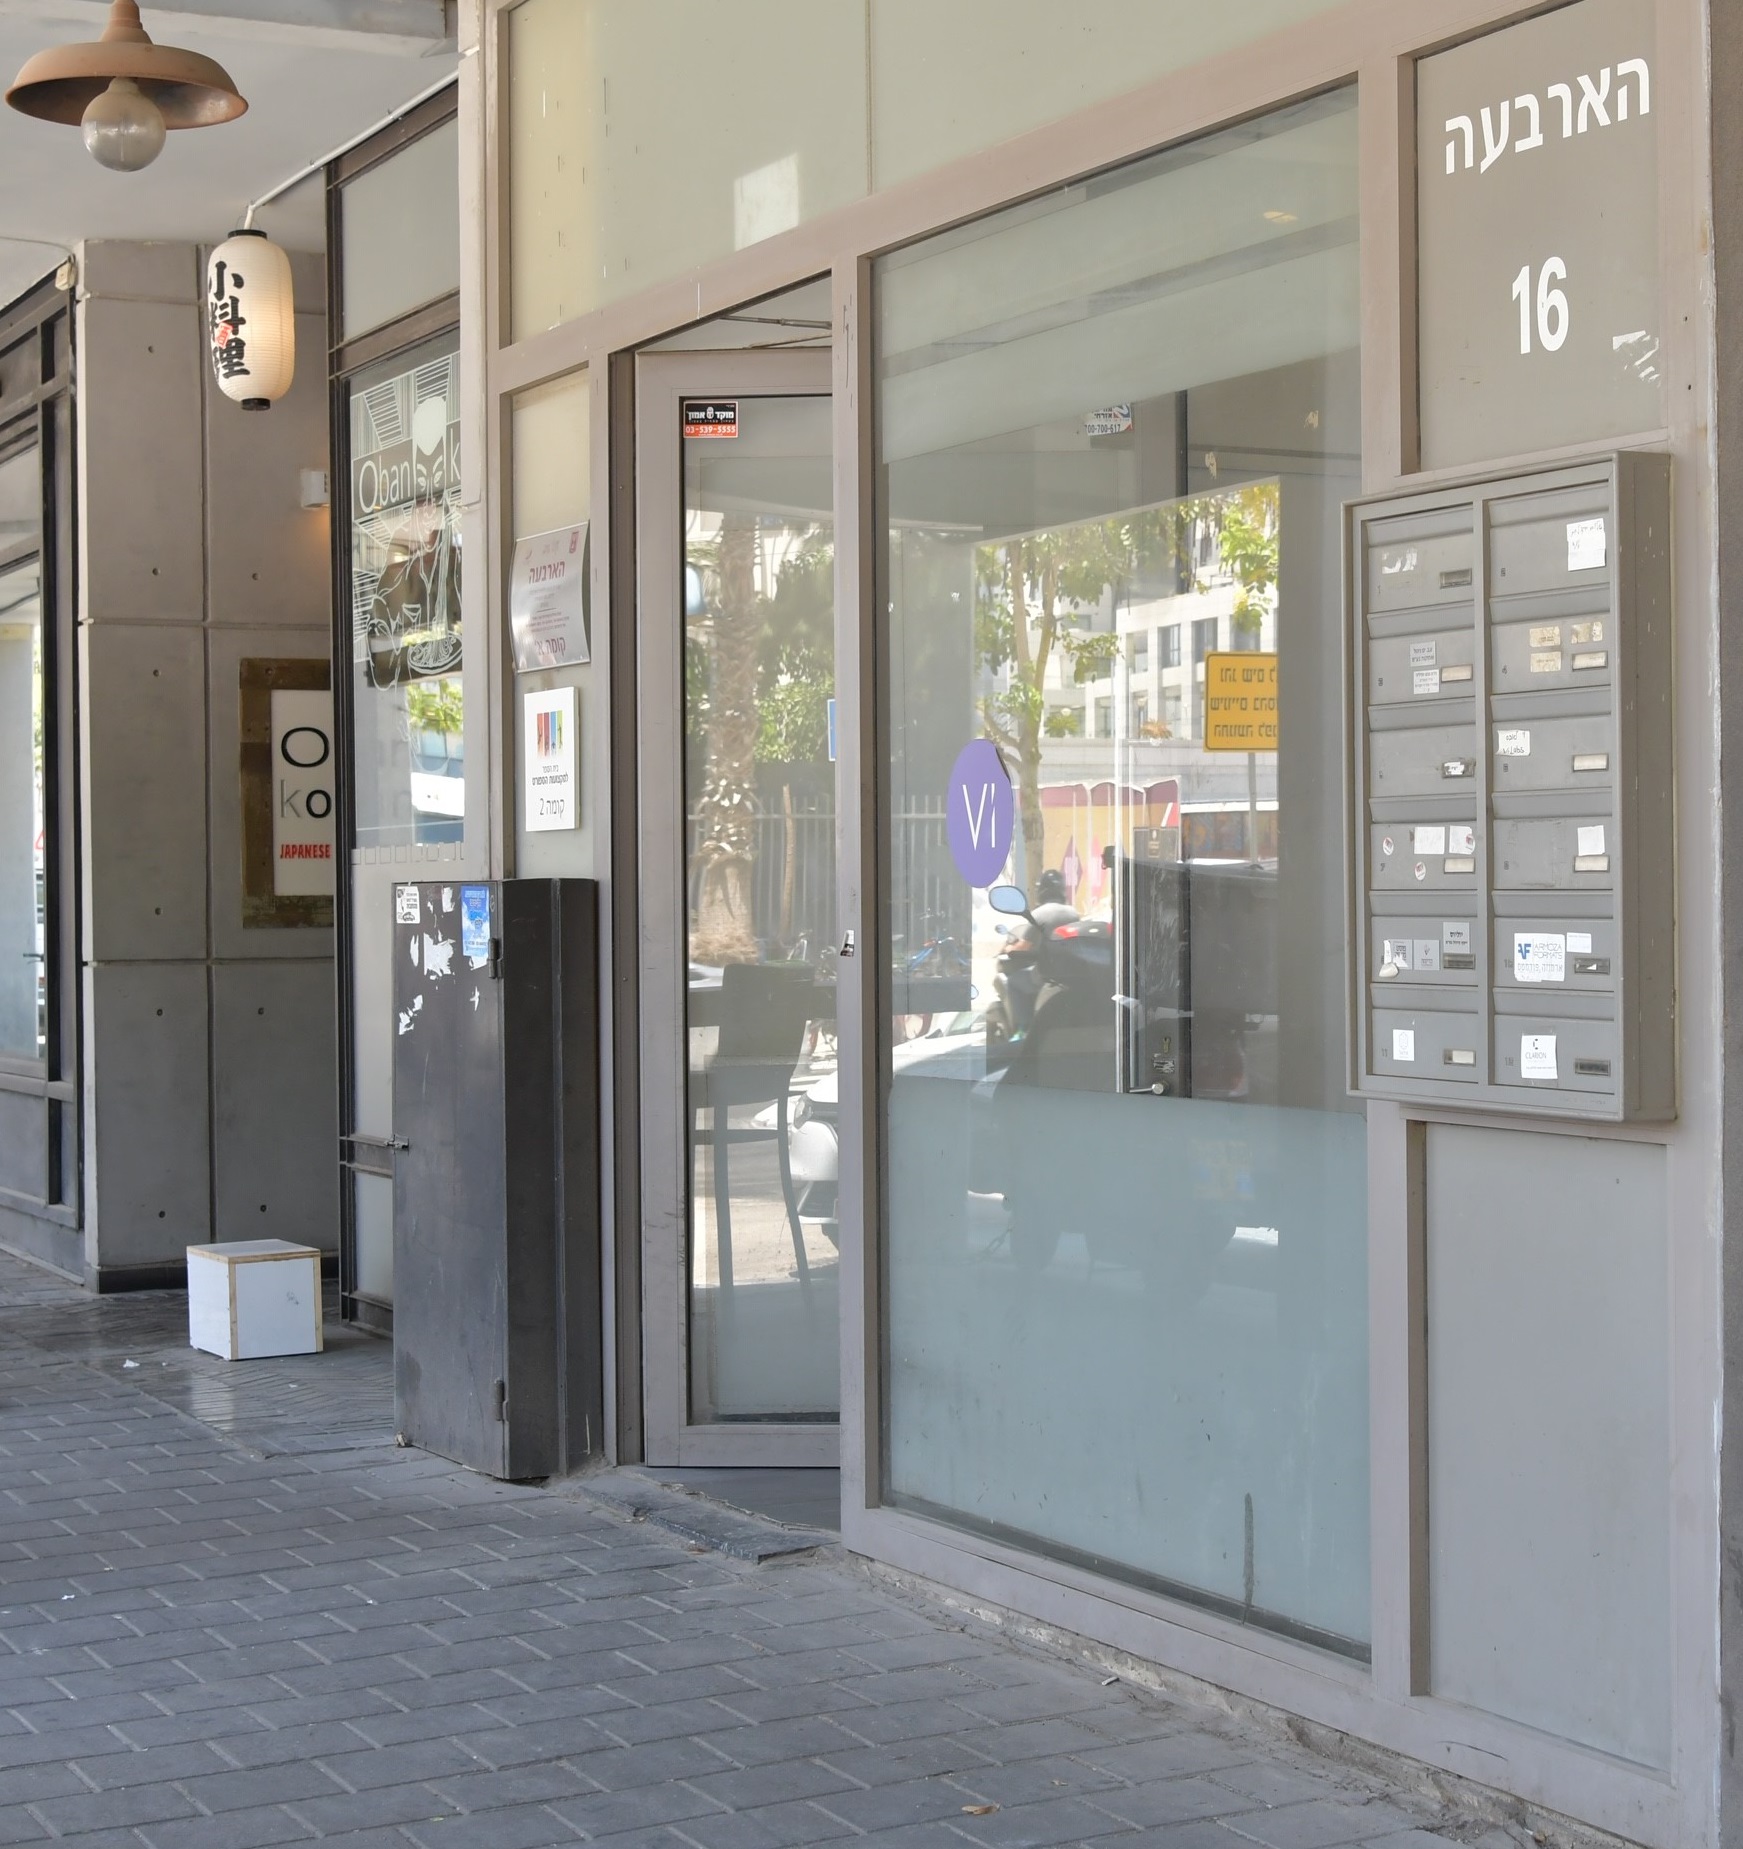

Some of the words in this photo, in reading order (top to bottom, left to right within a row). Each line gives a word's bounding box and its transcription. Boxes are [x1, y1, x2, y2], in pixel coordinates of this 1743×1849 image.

[1445, 58, 1650, 174] הארבעה
[1512, 256, 1569, 354] 16
[687, 411, 706, 421] אמון
[715, 411, 734, 420] מוקד
[685, 425, 736, 434] 03-539-5555
[358, 453, 411, 514] Oban
[528, 560, 566, 584] הארבעה
[545, 637, 566, 657] קומה
[280, 779, 332, 819] ko
[539, 797, 545, 816] 2
[546, 799, 565, 819] קומה
[280, 842, 332, 860] JAPANESE
[1533, 951, 1563, 960] FORMATS
[1534, 943, 1563, 951] ARMOZA
[1525, 1052, 1547, 1060] CLARION
